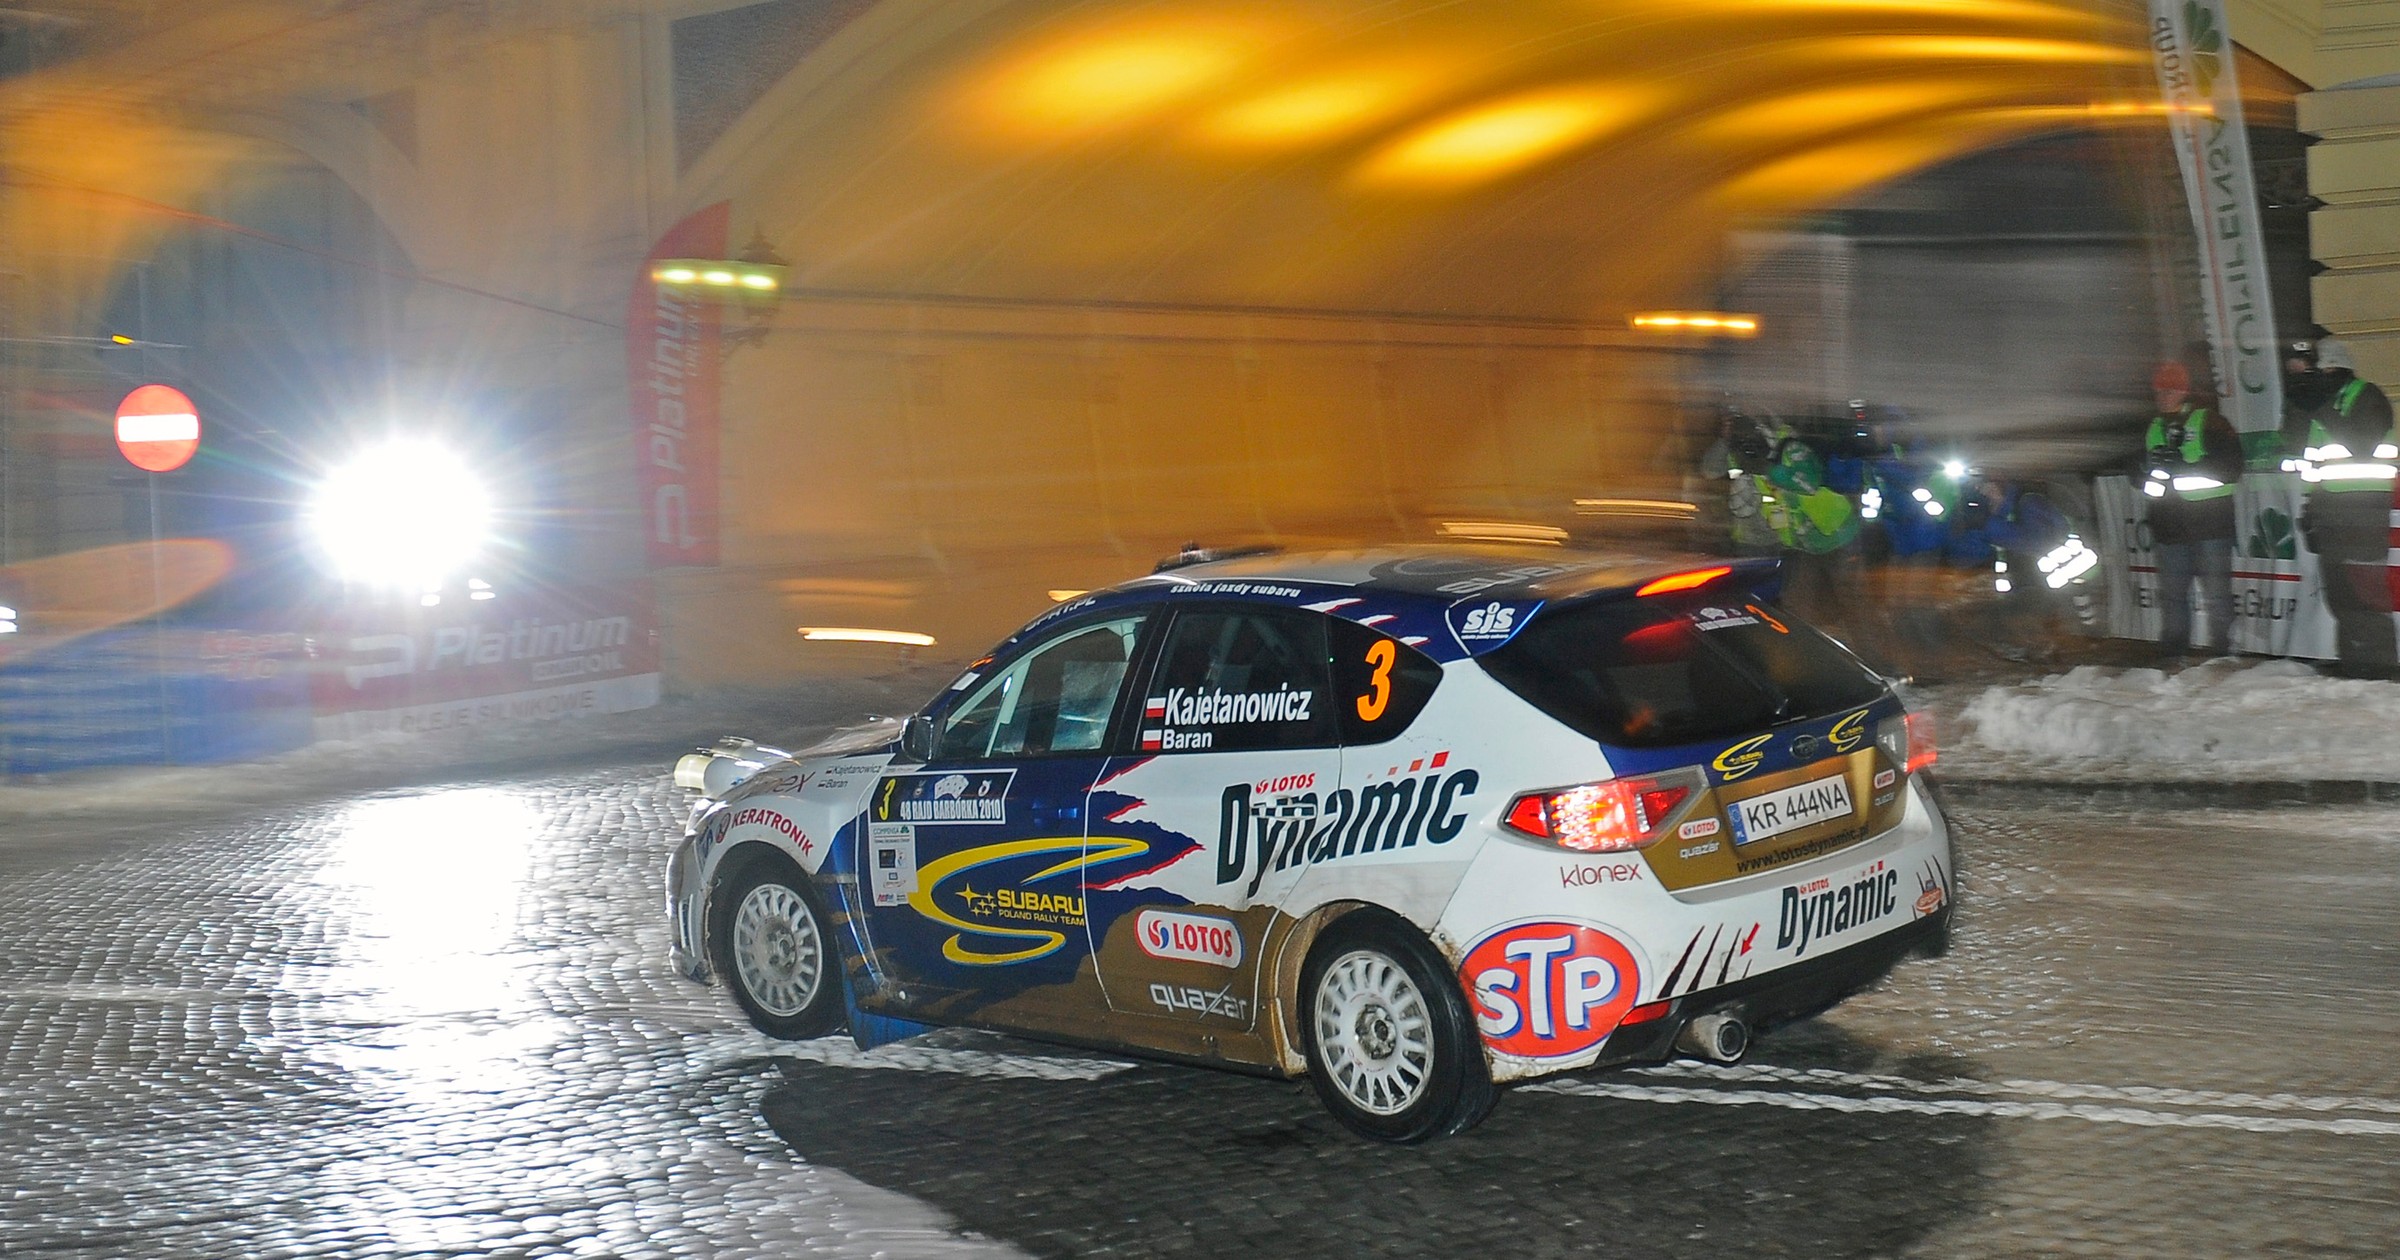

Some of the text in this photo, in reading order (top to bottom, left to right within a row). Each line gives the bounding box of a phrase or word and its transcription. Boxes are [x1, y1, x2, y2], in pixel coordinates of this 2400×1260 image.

[1251, 585, 1301, 598] subaru
[1463, 602, 1516, 634] sjs
[1745, 604, 1789, 633] 3
[427, 616, 630, 671] Platinum
[1357, 639, 1396, 722] 3
[1164, 682, 1312, 726] Kajetanowicz
[1162, 729, 1212, 750] Baran
[824, 779, 849, 789] Baran
[831, 764, 882, 776] Kajetanowicz
[1271, 773, 1316, 793] LOTOS
[878, 778, 896, 820] 3
[912, 800, 932, 820] RAJD
[933, 797, 979, 820] BARBÓRKA
[979, 798, 1001, 820] 2010
[1746, 783, 1848, 832] KR 444NA
[731, 808, 814, 858] KERATRONIK
[1216, 754, 1480, 898] Dynamic
[1692, 821, 1716, 834] LOTOS
[1680, 841, 1720, 859] quazar
[1559, 862, 1643, 889] klonex
[1807, 878, 1829, 893] LOTOS
[997, 889, 1084, 916] SUBARU
[1776, 862, 1898, 957] Dynamic
[998, 909, 1086, 927] POLAND RALLY TEAM
[1173, 924, 1233, 958] LOTOS
[1475, 934, 1622, 1040] STP
[1150, 984, 1247, 1021] quazar
